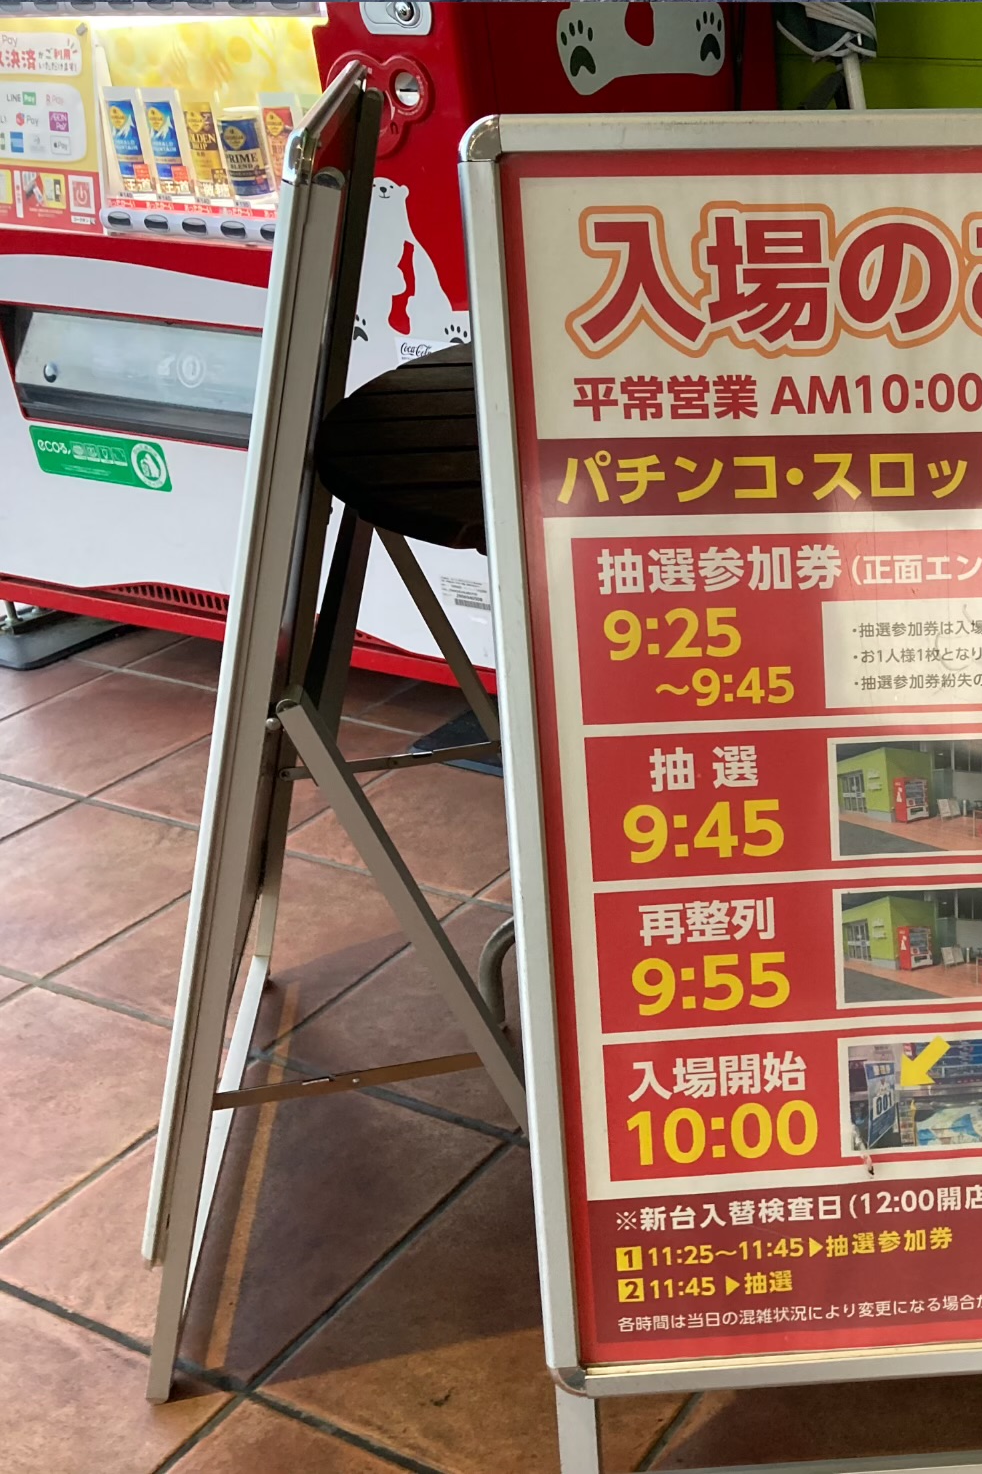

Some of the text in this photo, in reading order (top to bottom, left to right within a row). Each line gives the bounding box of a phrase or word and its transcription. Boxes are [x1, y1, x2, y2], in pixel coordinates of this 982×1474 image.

[6, 93, 22, 103] LINE
[572, 373, 760, 423] 平常営業
[596, 543, 843, 595] 抽選参加券
[603, 606, 742, 662] 9:25
[622, 799, 785, 864] 9:45
[637, 896, 777, 948] 再整列
[630, 950, 792, 1017] 9:55
[627, 1050, 808, 1103] 入場開始
[876, 1092, 893, 1116] 001
[625, 1098, 820, 1167] 10:00
[825, 1226, 954, 1259] 抽選参加券
[649, 1276, 717, 1299] 11:45
[743, 1270, 794, 1296] 抽選
